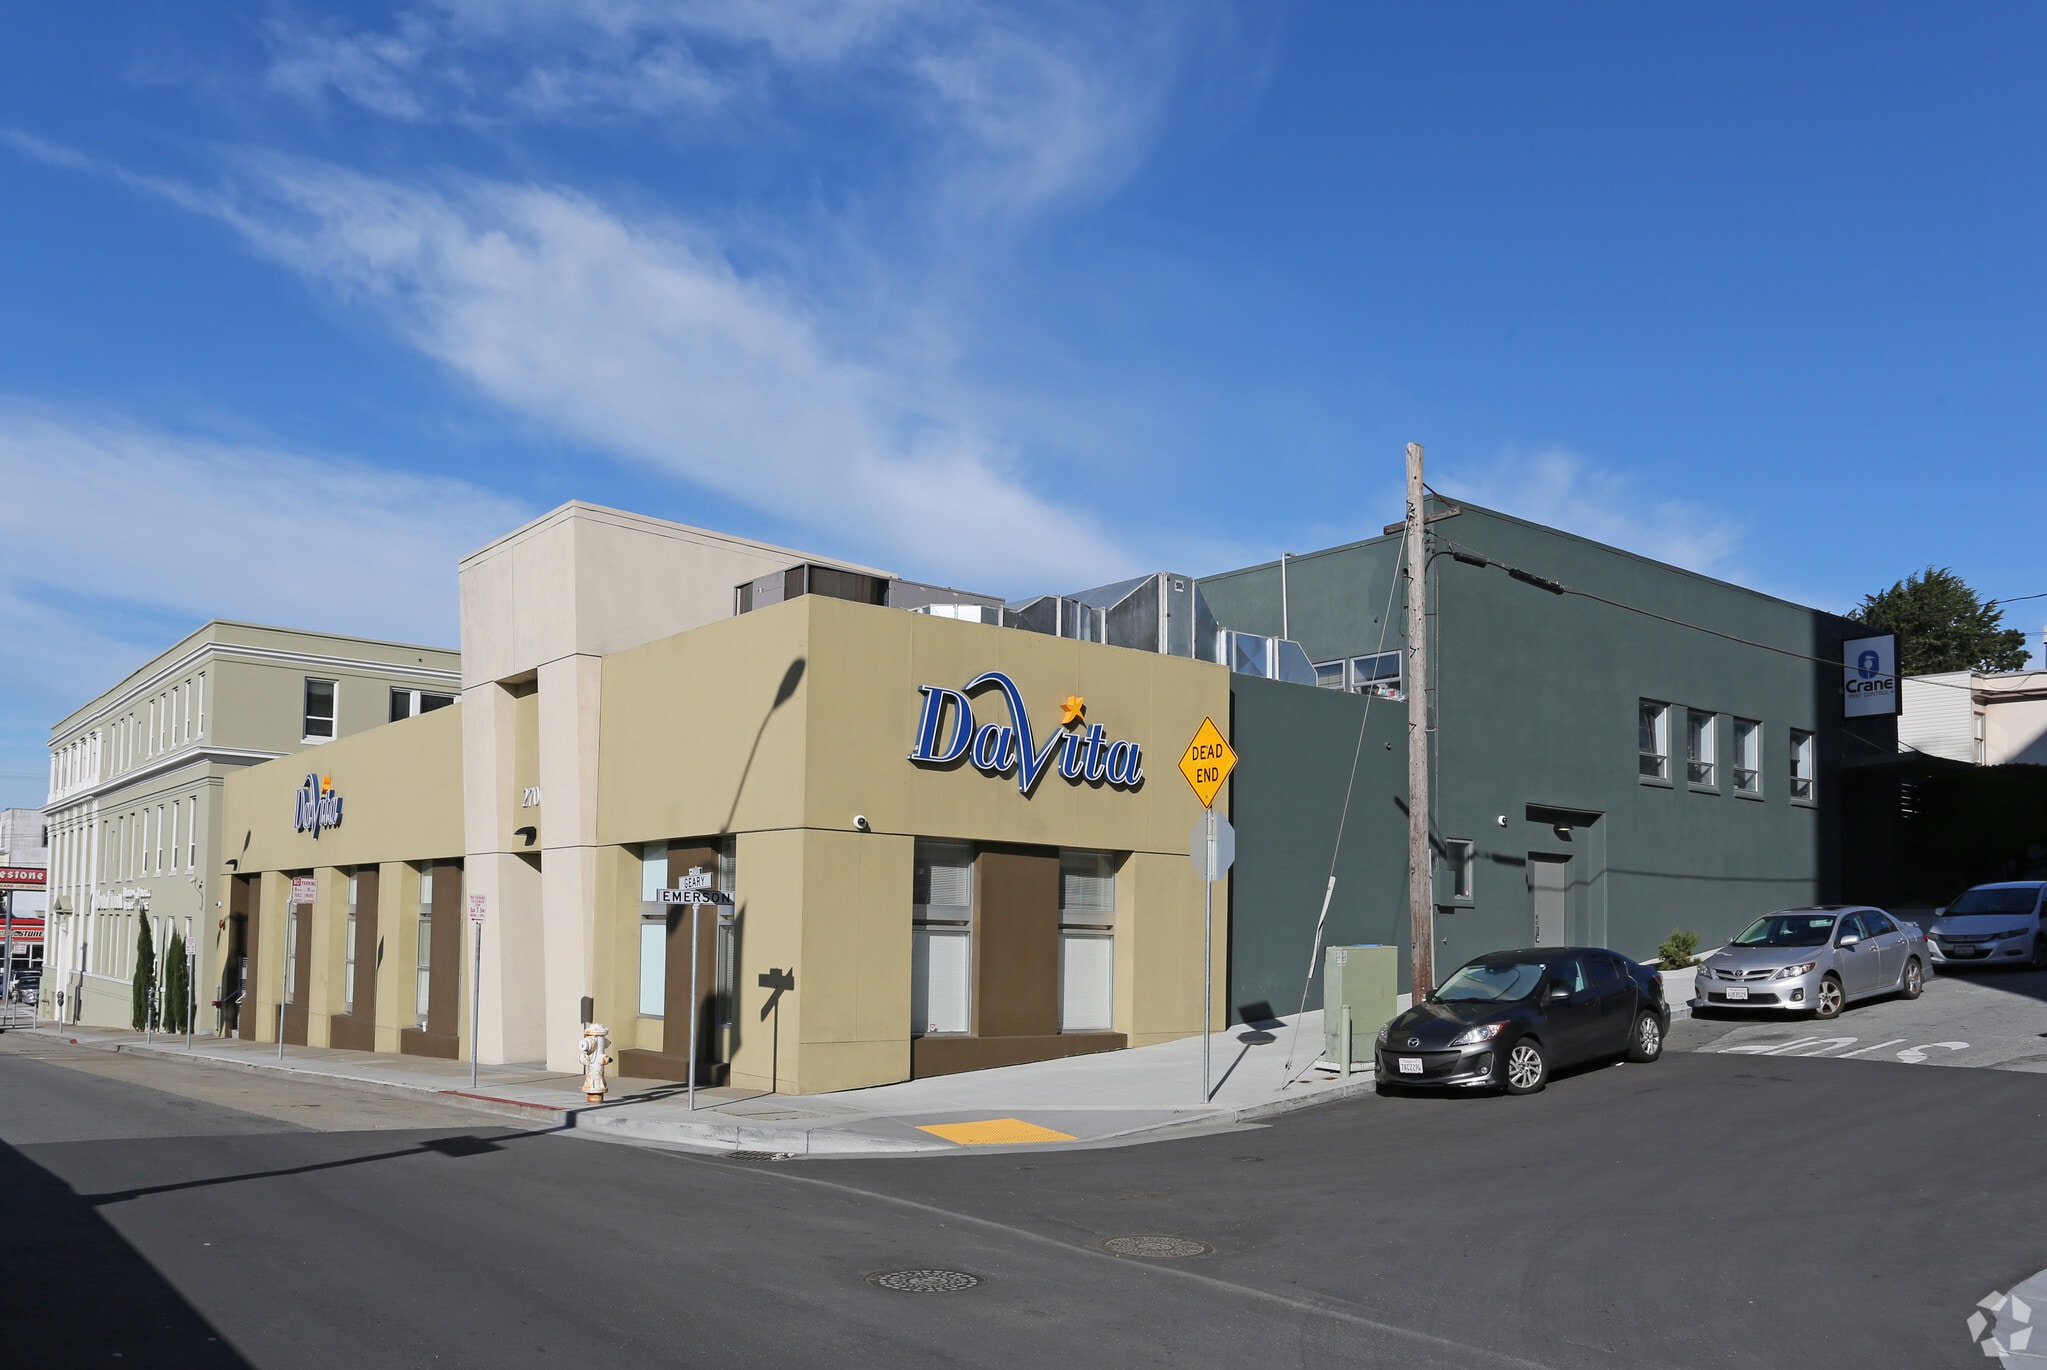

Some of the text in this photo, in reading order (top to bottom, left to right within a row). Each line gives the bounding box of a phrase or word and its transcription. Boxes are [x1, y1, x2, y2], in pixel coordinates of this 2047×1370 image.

[1846, 679, 1893, 693] Crane
[907, 671, 1143, 794] DaVita
[1192, 744, 1223, 761] DEAD
[1196, 767, 1219, 783] END
[522, 786, 540, 808] 270
[294, 773, 343, 840] DaVita
[684, 876, 705, 888] GEARY
[663, 891, 730, 903] EMERSON
